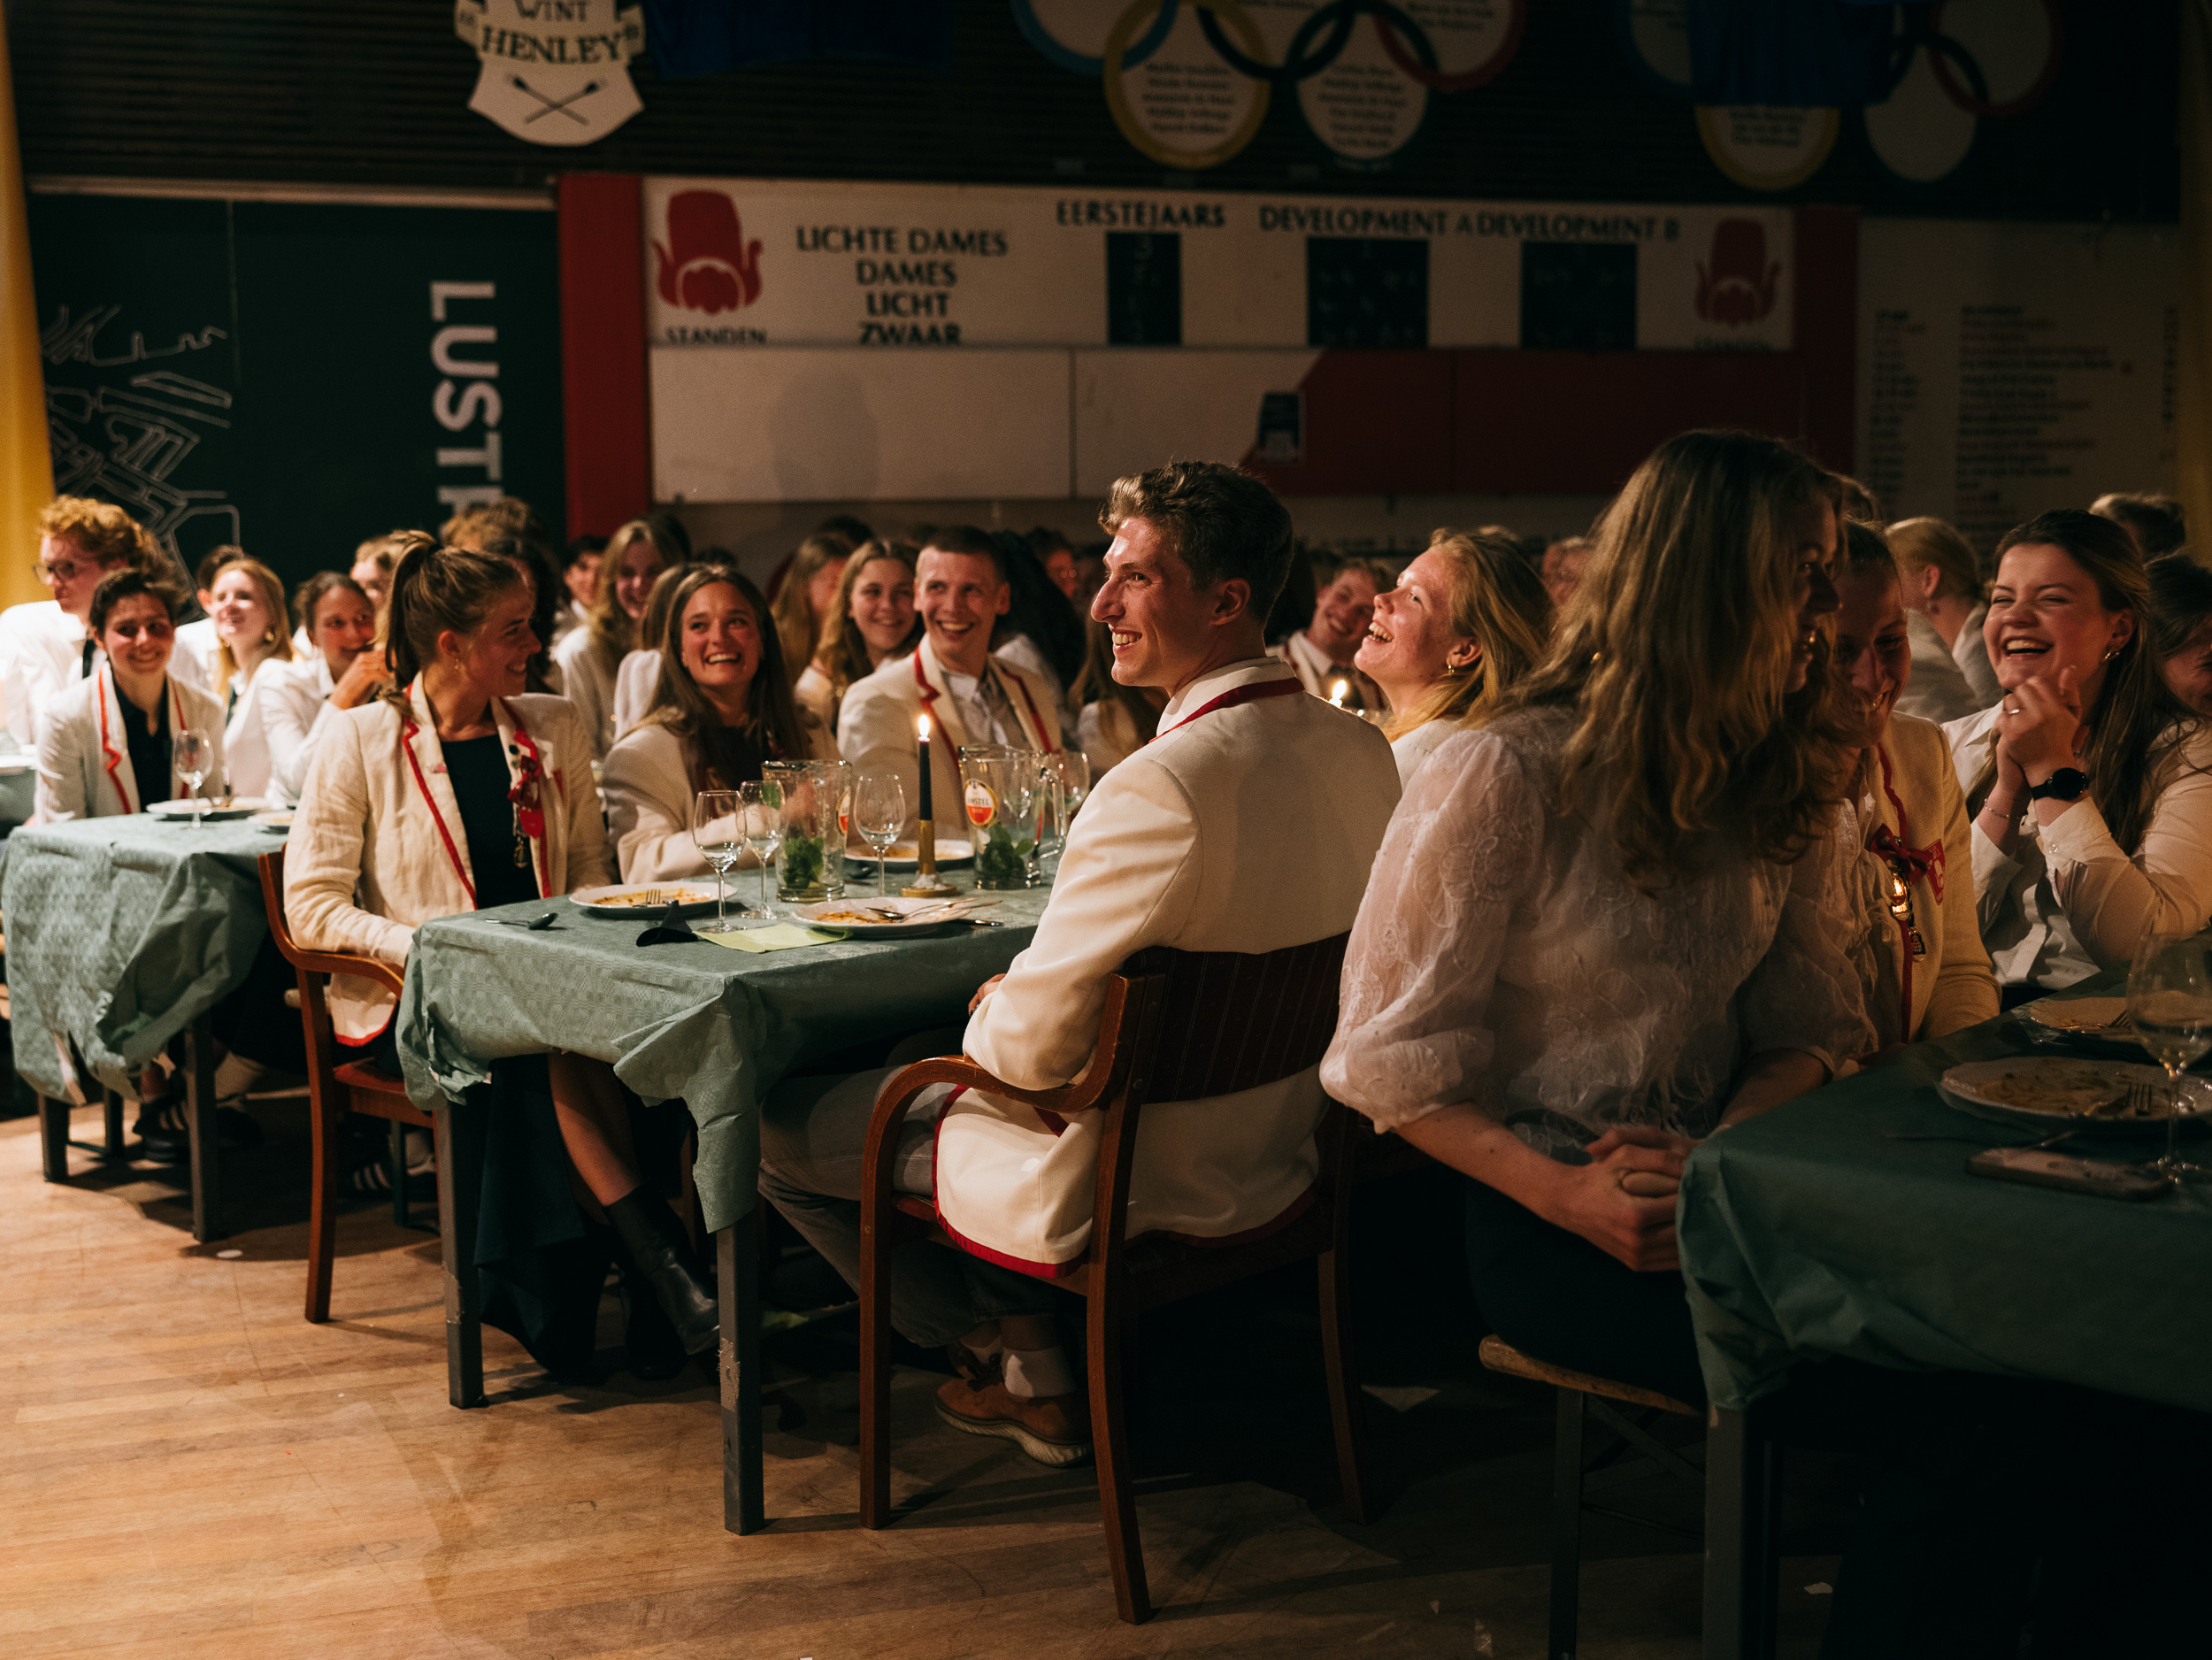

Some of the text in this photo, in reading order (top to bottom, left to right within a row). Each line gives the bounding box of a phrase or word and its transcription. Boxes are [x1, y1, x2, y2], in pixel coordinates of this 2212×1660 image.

[482, 26, 623, 64] HENLEY
[1057, 201, 1226, 228] EERSTEJAARS
[1260, 205, 1447, 235] DEVELOPMENT
[1477, 214, 1657, 241] DEVELOPMENT
[797, 226, 1009, 257] LICHTE DAMES
[856, 259, 956, 288] DAMES
[866, 292, 950, 319] LICHT
[858, 322, 962, 346] ZWAAR
